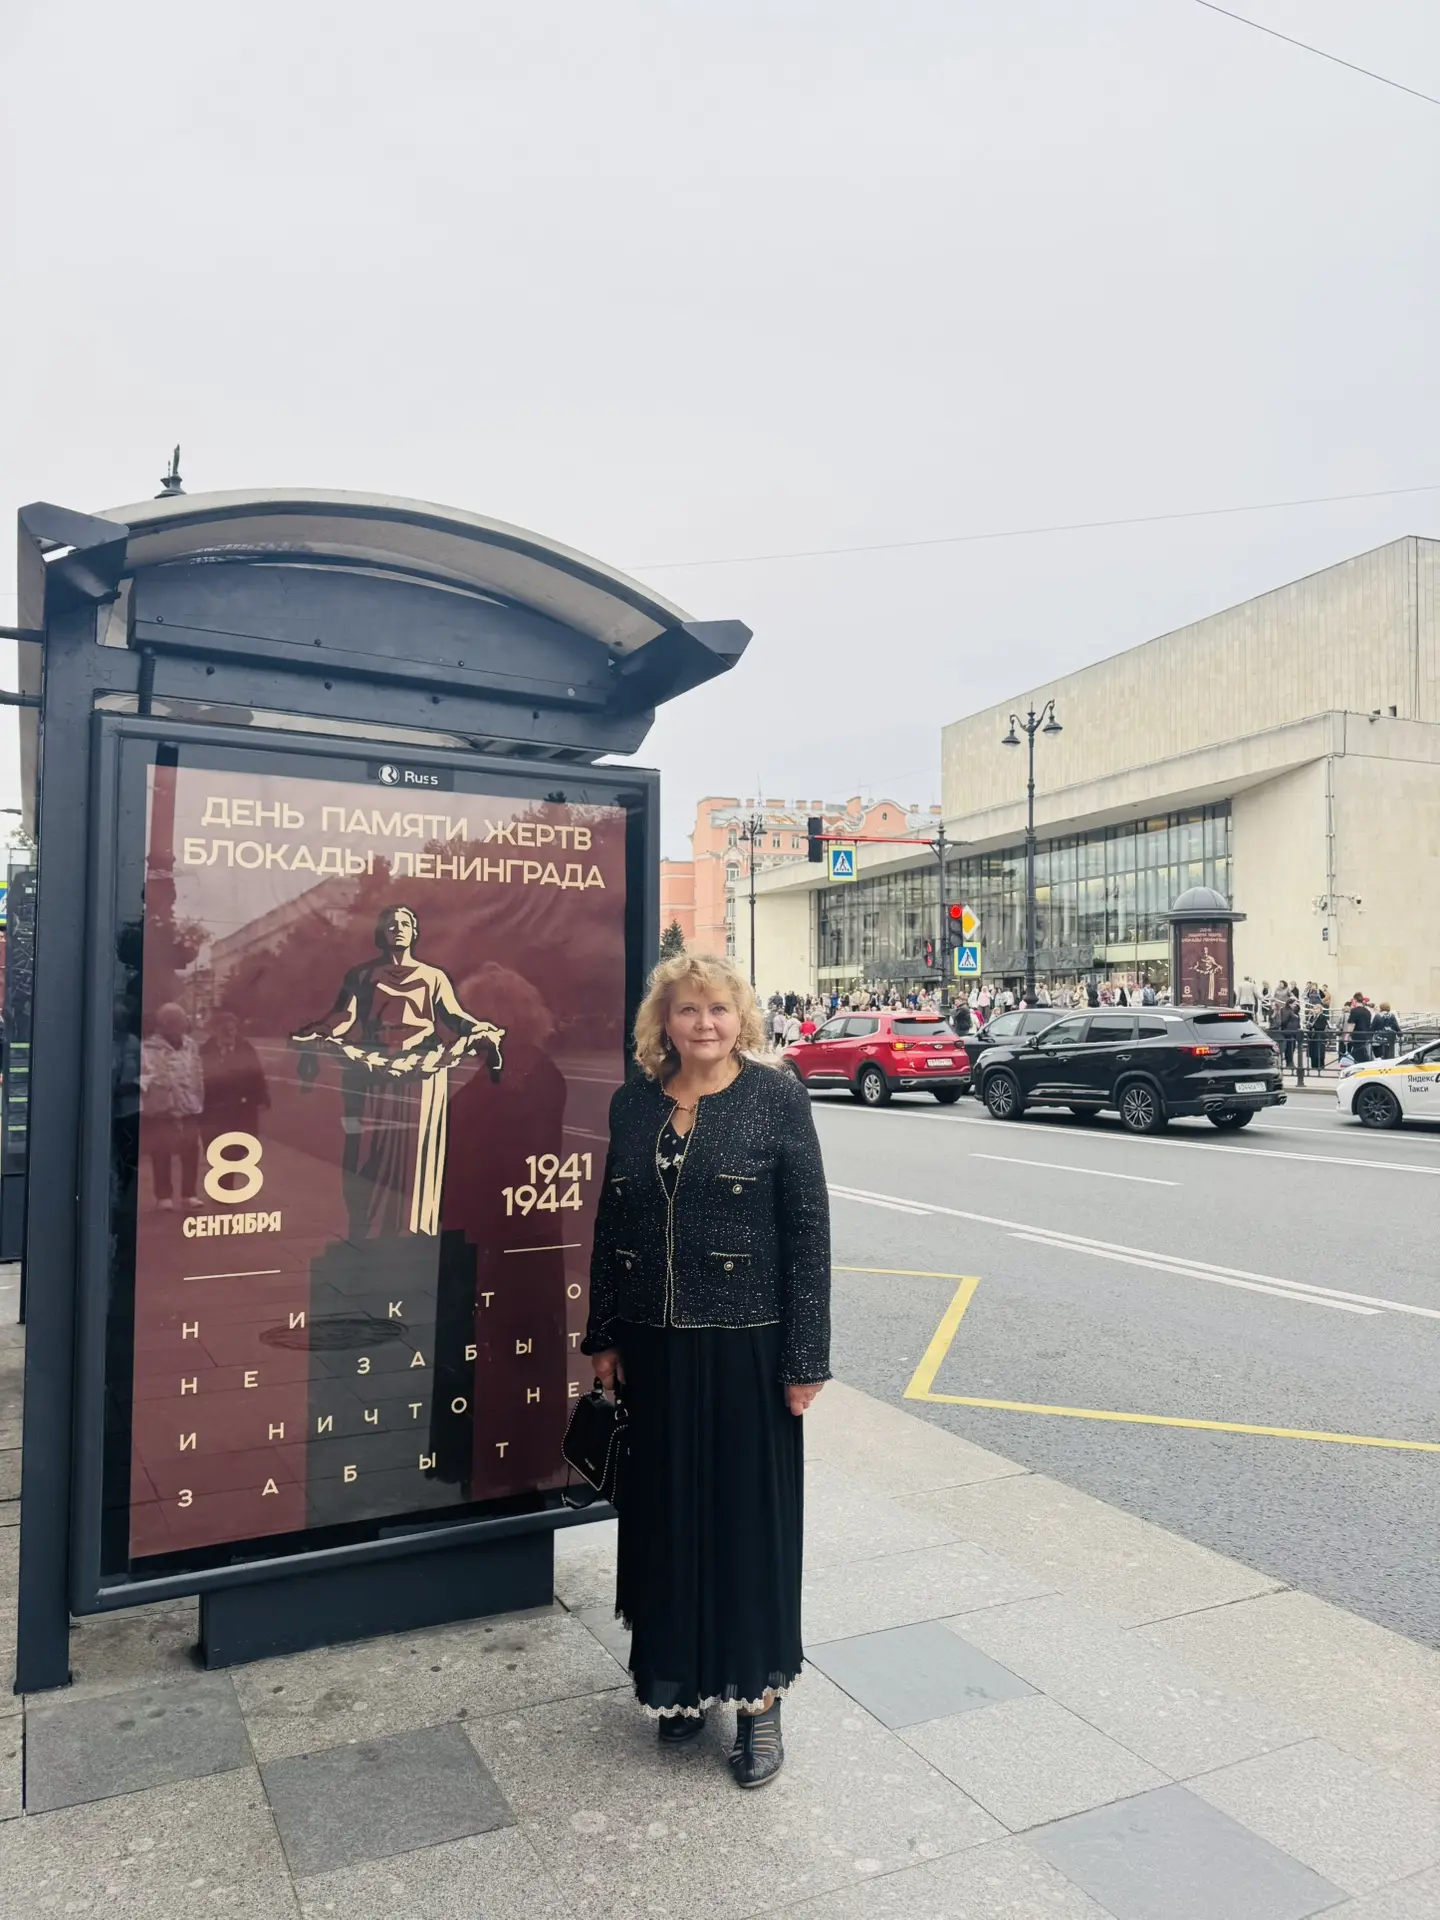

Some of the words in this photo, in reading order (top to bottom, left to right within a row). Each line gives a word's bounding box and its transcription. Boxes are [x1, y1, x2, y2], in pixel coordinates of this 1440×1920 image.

[404, 770, 439, 786] Russ
[201, 796, 305, 829] ДЕНЬ
[321, 806, 468, 842] ПАМЯТИ
[483, 818, 593, 851] ЖЕРТВ
[183, 837, 374, 877] БЛОКАДЫ
[388, 851, 606, 891] ЛЕНИНГРАДА
[1407, 1074, 1435, 1083] Яндекс
[1408, 1084, 1429, 1092] Такси
[203, 1131, 264, 1204] 8
[525, 1152, 592, 1185] 1941
[501, 1182, 583, 1216] 1944
[182, 1210, 282, 1238] СЕНТЯБРЯ
[177, 1441, 510, 1508] ЗАБЫТ
